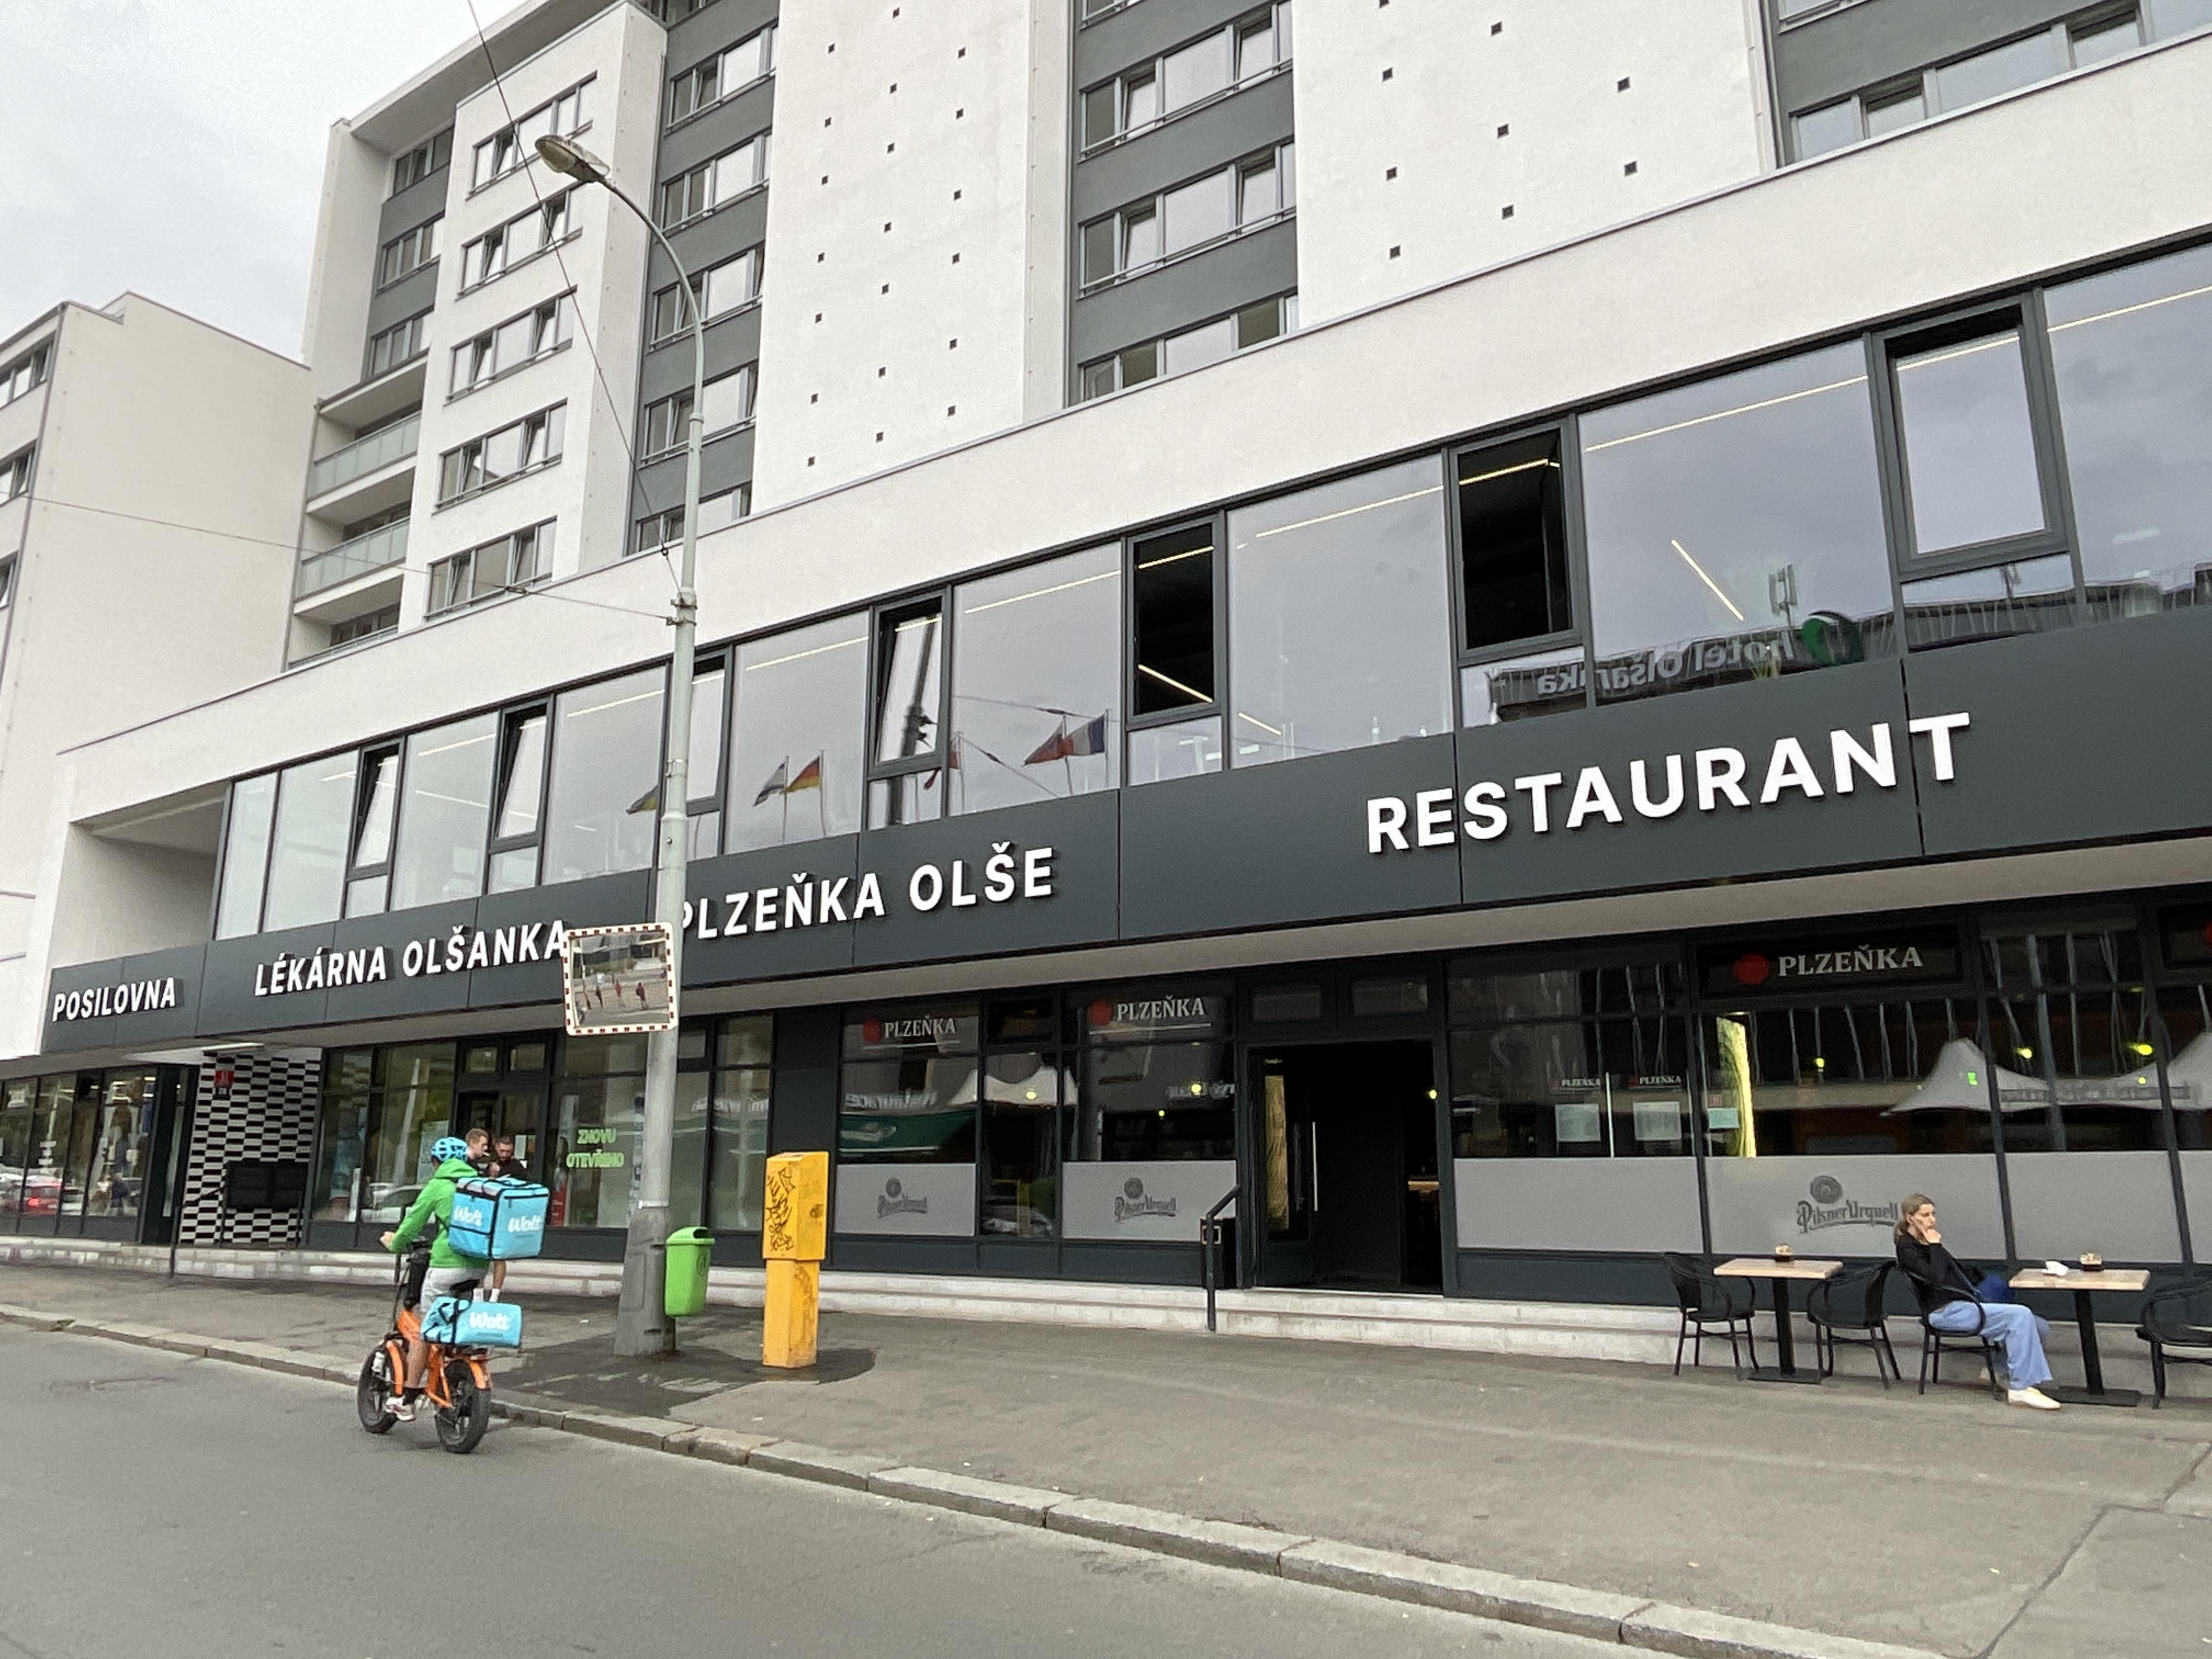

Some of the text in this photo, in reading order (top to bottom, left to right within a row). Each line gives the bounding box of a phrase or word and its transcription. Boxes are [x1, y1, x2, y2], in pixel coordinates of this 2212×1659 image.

[1367, 712, 1971, 854] RESTAURANT
[909, 842, 1053, 912] OLŠE
[254, 919, 565, 997] LÉKÁRNA OLŠANKA
[1778, 943, 1924, 977] PLZEŇKA
[52, 977, 176, 1022] POSILOVNA
[1117, 994, 1205, 1021] PLZEŇKA
[885, 1014, 956, 1038] PLZEŇKA
[577, 1128, 616, 1144] ZNOVU
[453, 1206, 483, 1226] Wolt
[507, 1215, 541, 1233] Wolt
[469, 1311, 510, 1331] Wolt
